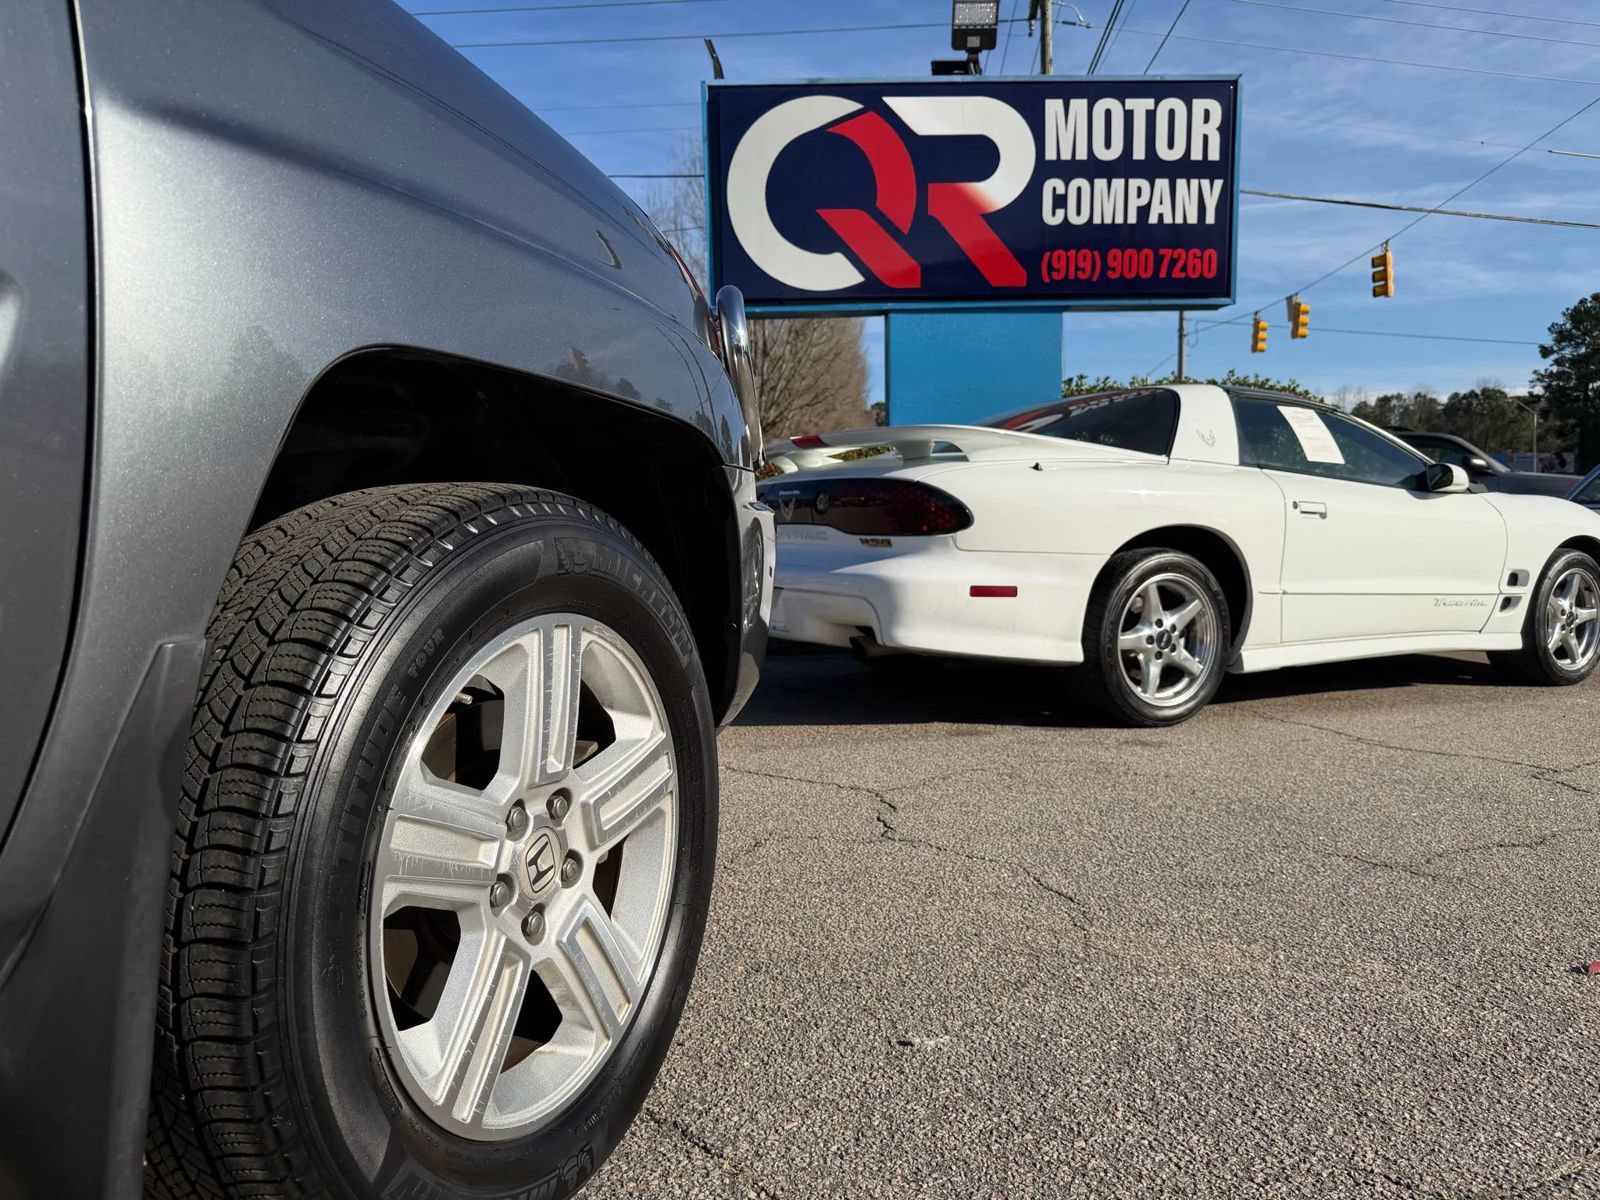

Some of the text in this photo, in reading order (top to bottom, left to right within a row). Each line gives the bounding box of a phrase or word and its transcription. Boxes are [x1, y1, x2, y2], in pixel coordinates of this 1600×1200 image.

[1044, 97, 1222, 162] MOTOR
[726, 95, 1037, 291] QR
[1041, 177, 1224, 226] COMPANY
[1041, 248, 1218, 283] (919) 900 7260
[592, 541, 694, 669] MICHELIN
[407, 627, 445, 679] TOUR
